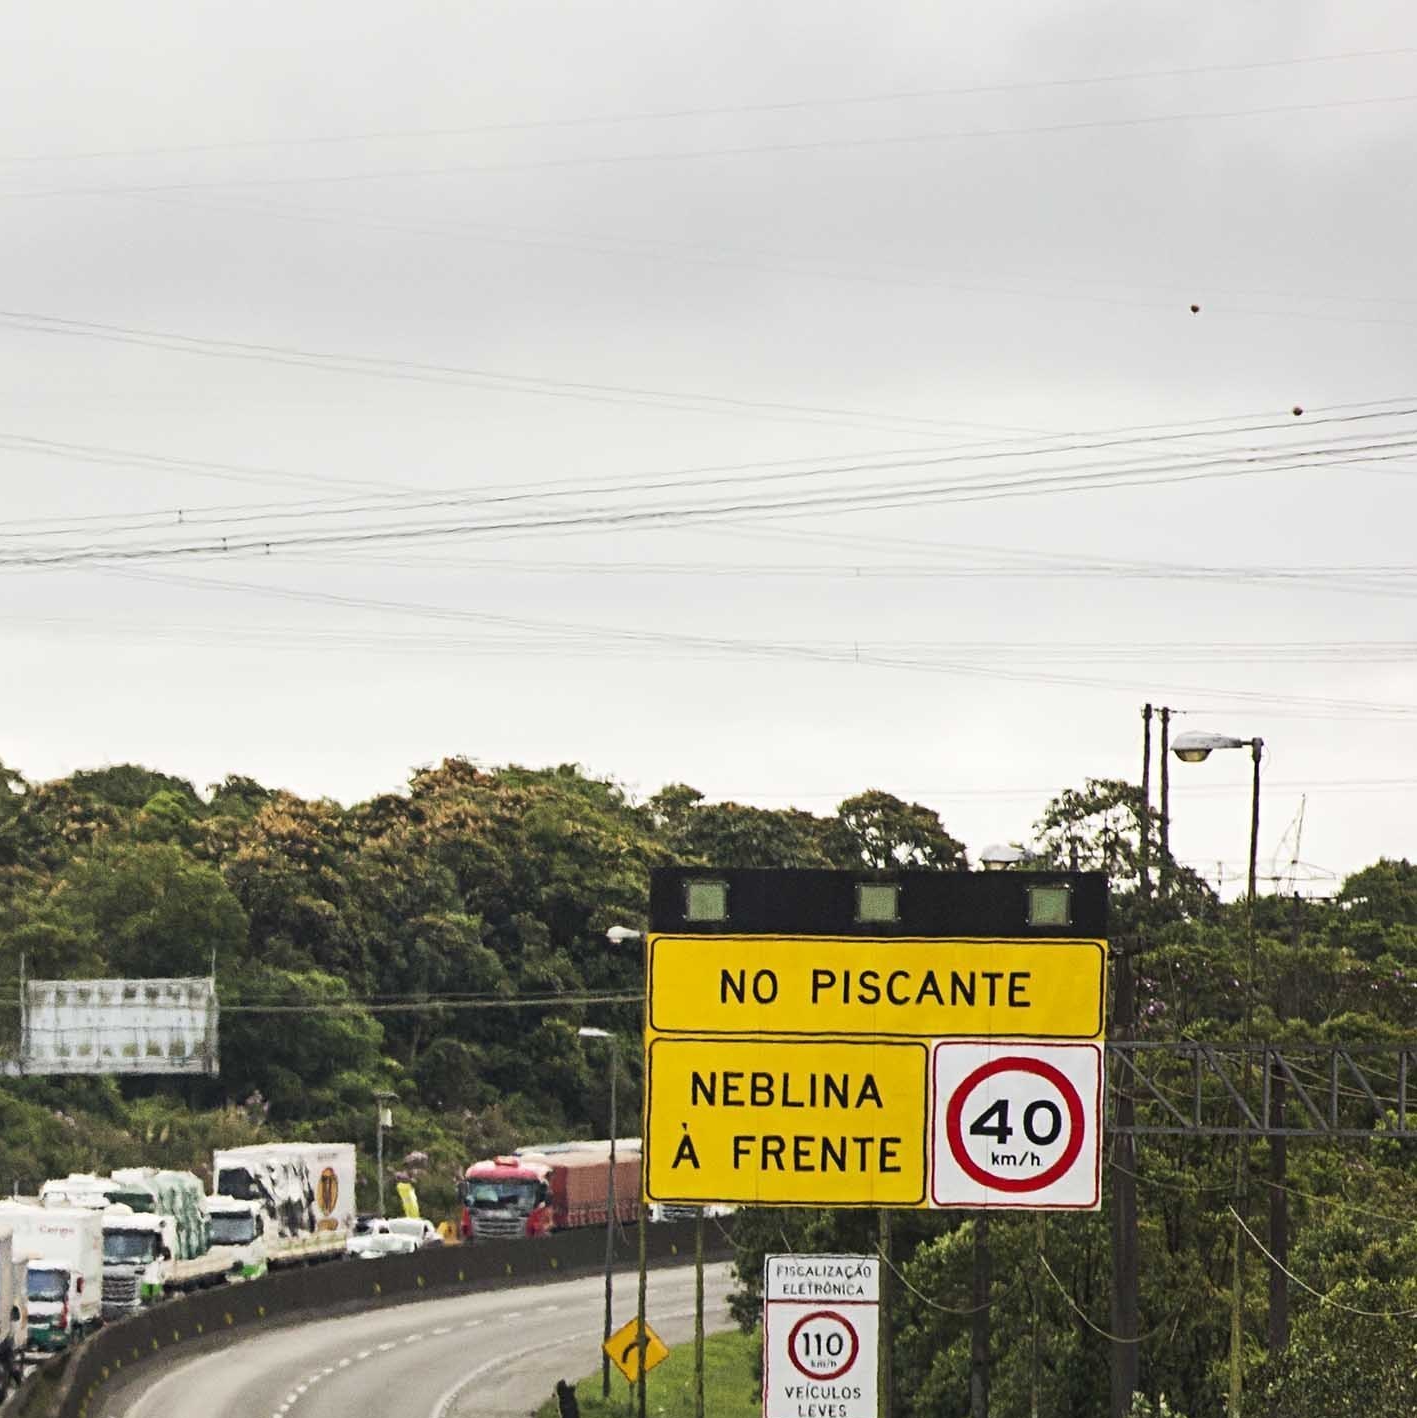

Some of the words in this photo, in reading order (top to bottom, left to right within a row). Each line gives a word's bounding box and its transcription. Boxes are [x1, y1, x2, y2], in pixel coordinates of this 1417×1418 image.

[720, 968, 779, 1005] NO
[811, 969, 1033, 1008] PISCANTE
[691, 1071, 884, 1110] NEBLINA
[968, 1098, 1063, 1145] 40
[671, 1122, 701, 1170] À
[733, 1135, 903, 1173] FRENTE
[991, 1151, 1041, 1167] km/h
[776, 1261, 872, 1280] FISCALIZAÇÃO
[782, 1282, 865, 1296] ELETRÔNICA
[802, 1332, 844, 1356] 110
[784, 1382, 862, 1400] VEÍCULOS
[797, 1404, 848, 1418] LEVES
